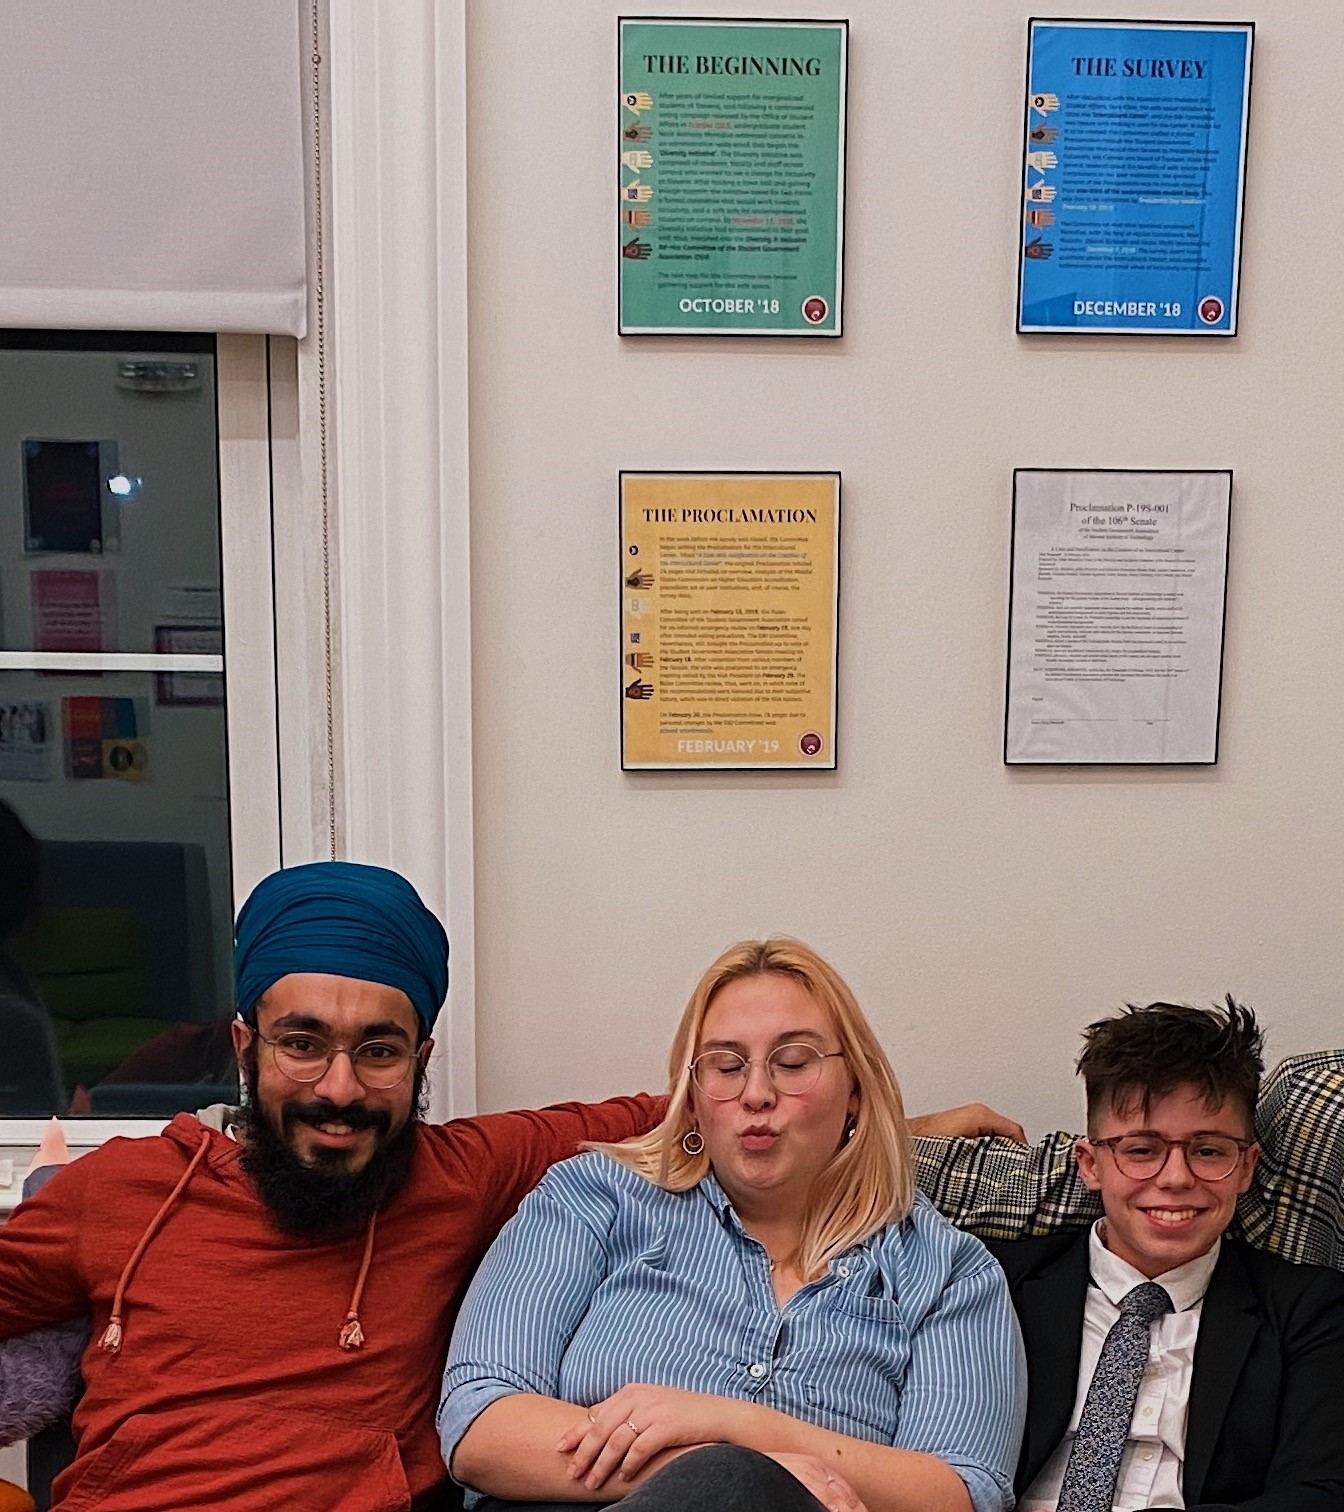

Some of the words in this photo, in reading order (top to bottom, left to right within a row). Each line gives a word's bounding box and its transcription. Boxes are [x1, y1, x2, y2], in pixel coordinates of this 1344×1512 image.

[642, 54, 690, 75] THE
[695, 54, 822, 77] BEGINNING
[1071, 56, 1117, 77] THE
[1122, 57, 1207, 79] SURVEY
[678, 298, 755, 314] OCTOBER
[757, 298, 780, 314] '18
[1073, 300, 1157, 317] DECEMBER
[1159, 302, 1182, 317] '18
[1069, 502, 1125, 512] Proclamation
[642, 508, 678, 523] THE
[681, 508, 818, 524] PROCLAMATION
[1081, 516, 1092, 525] of
[1092, 516, 1106, 526] the
[1130, 517, 1158, 527] Senate
[676, 739, 756, 753] FEBRUARY
